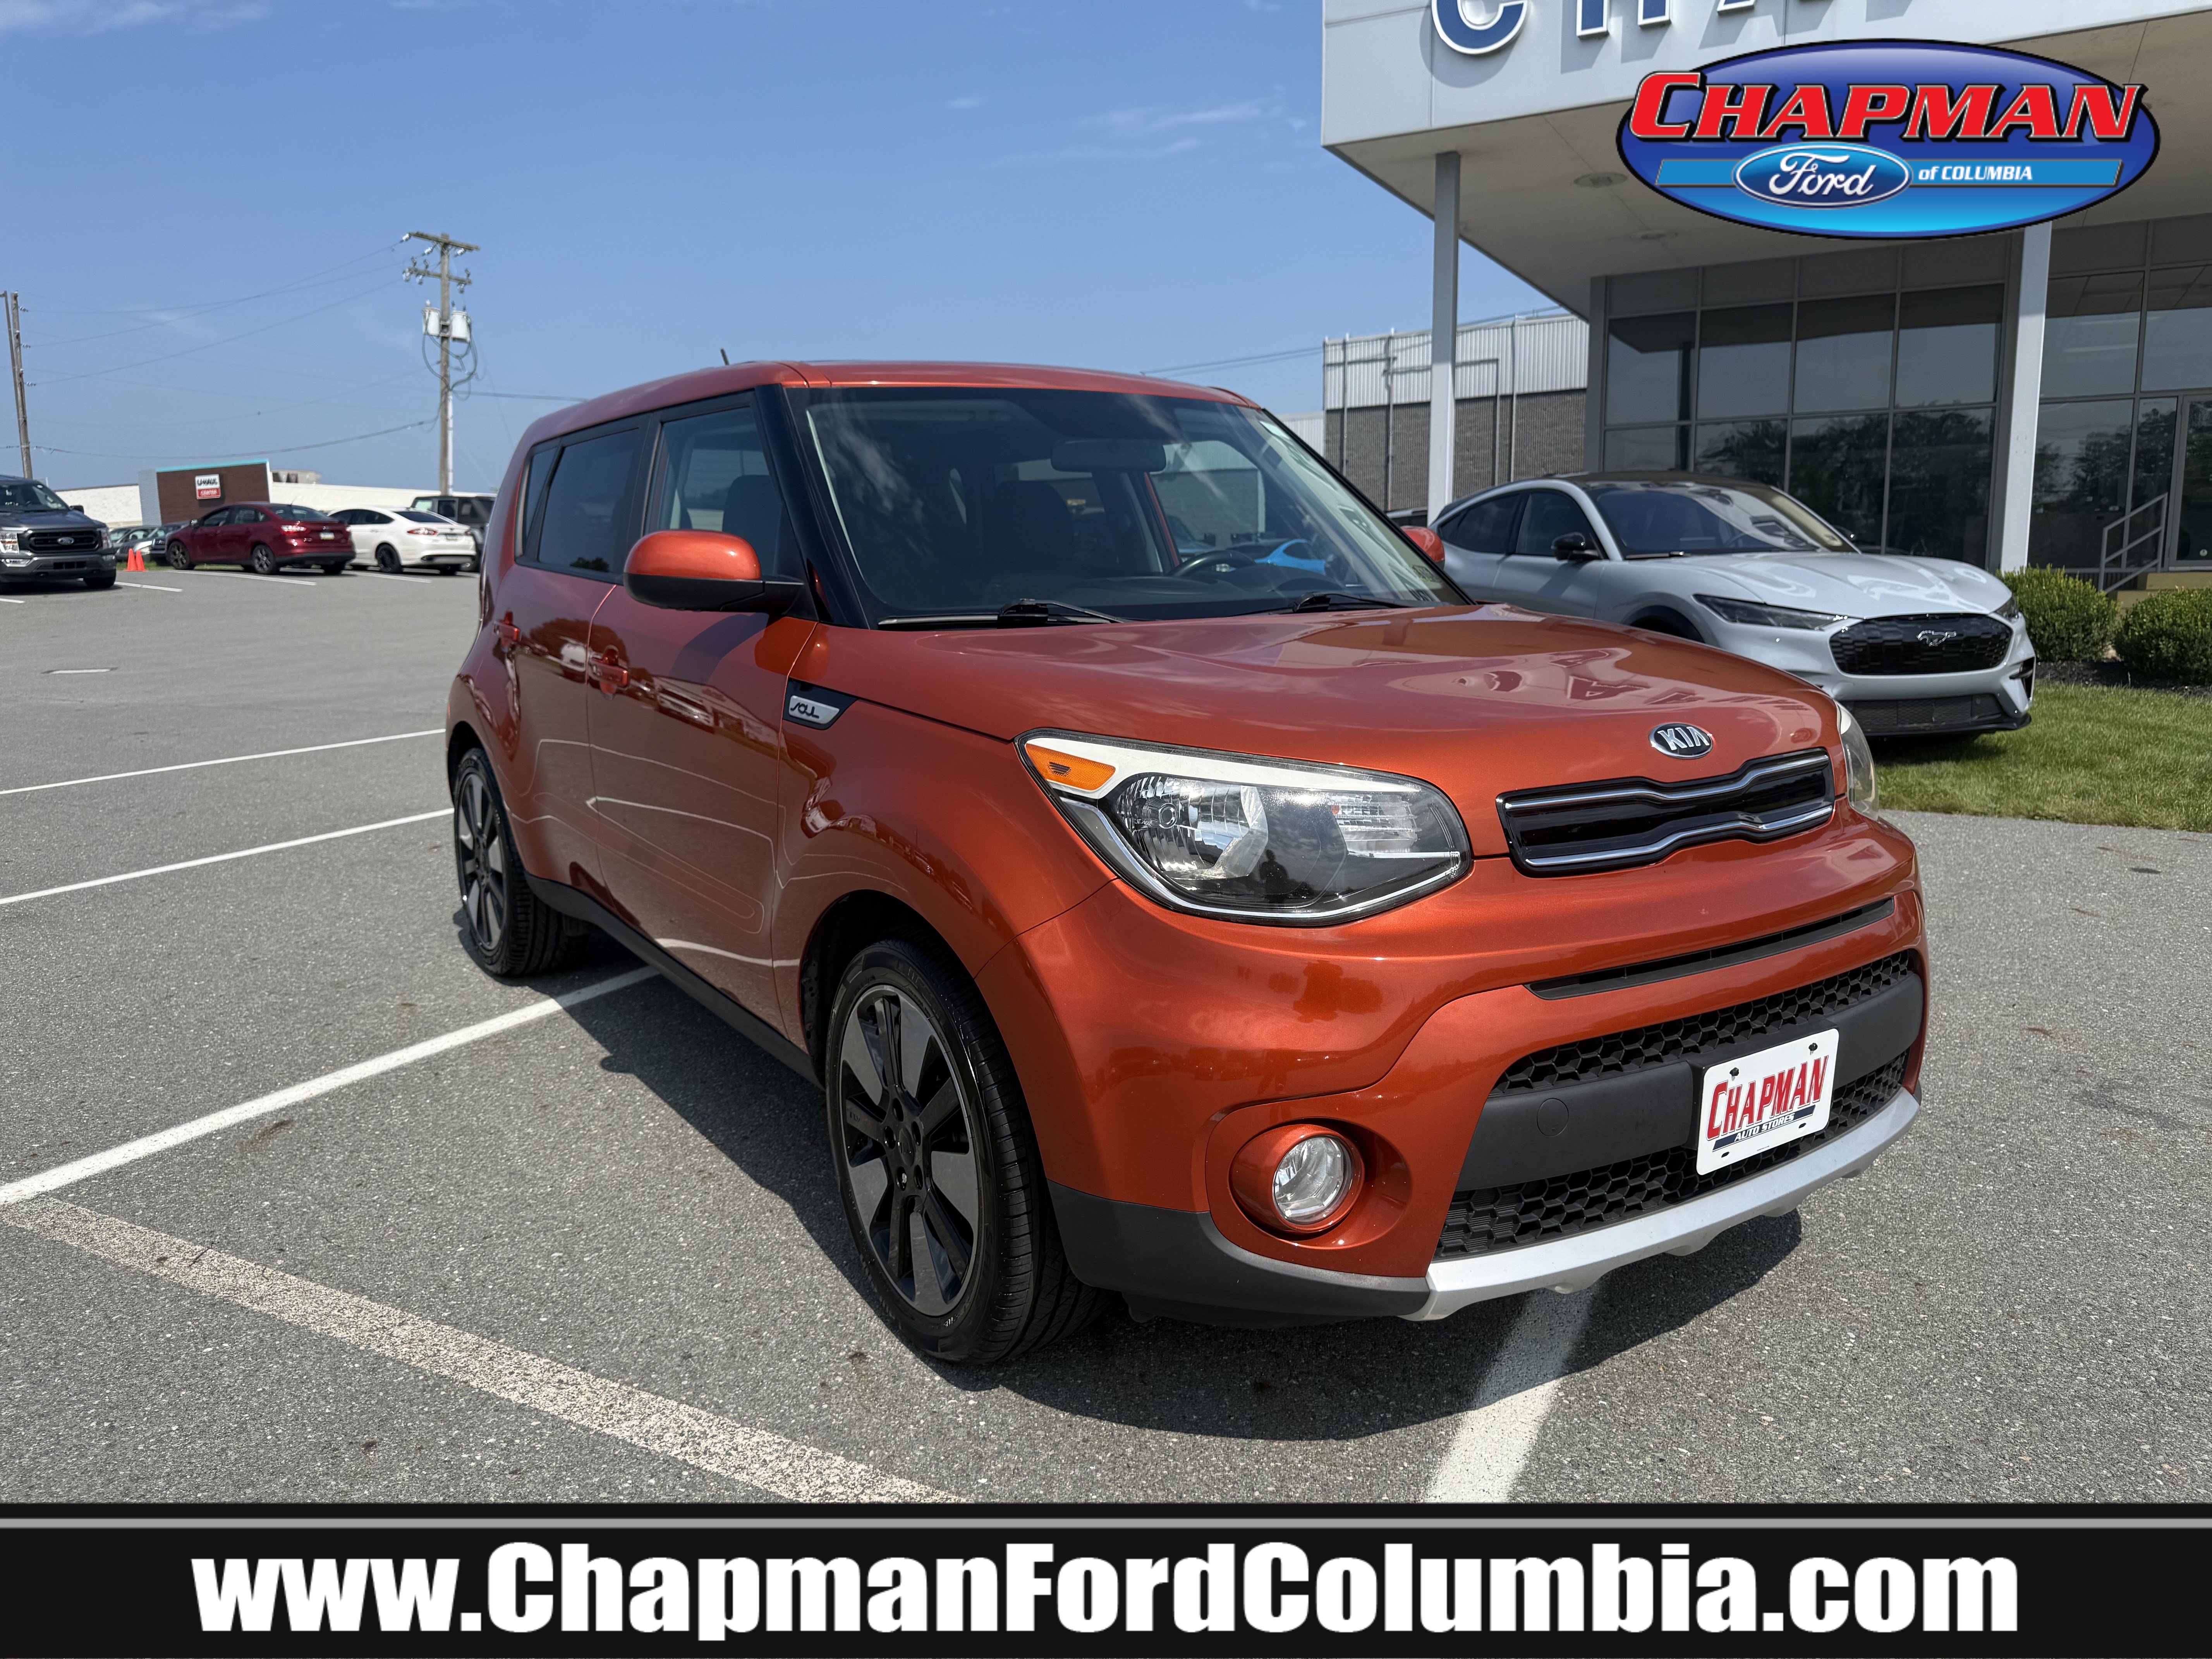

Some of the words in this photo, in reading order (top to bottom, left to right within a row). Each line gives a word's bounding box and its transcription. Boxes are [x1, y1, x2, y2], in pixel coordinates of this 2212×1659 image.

[1657, 726, 1710, 750] KIA
[1706, 1055, 1829, 1141] CHAPMAN
[1735, 1127, 1758, 1141] AUTO
[1761, 1113, 1795, 1132] STORES
